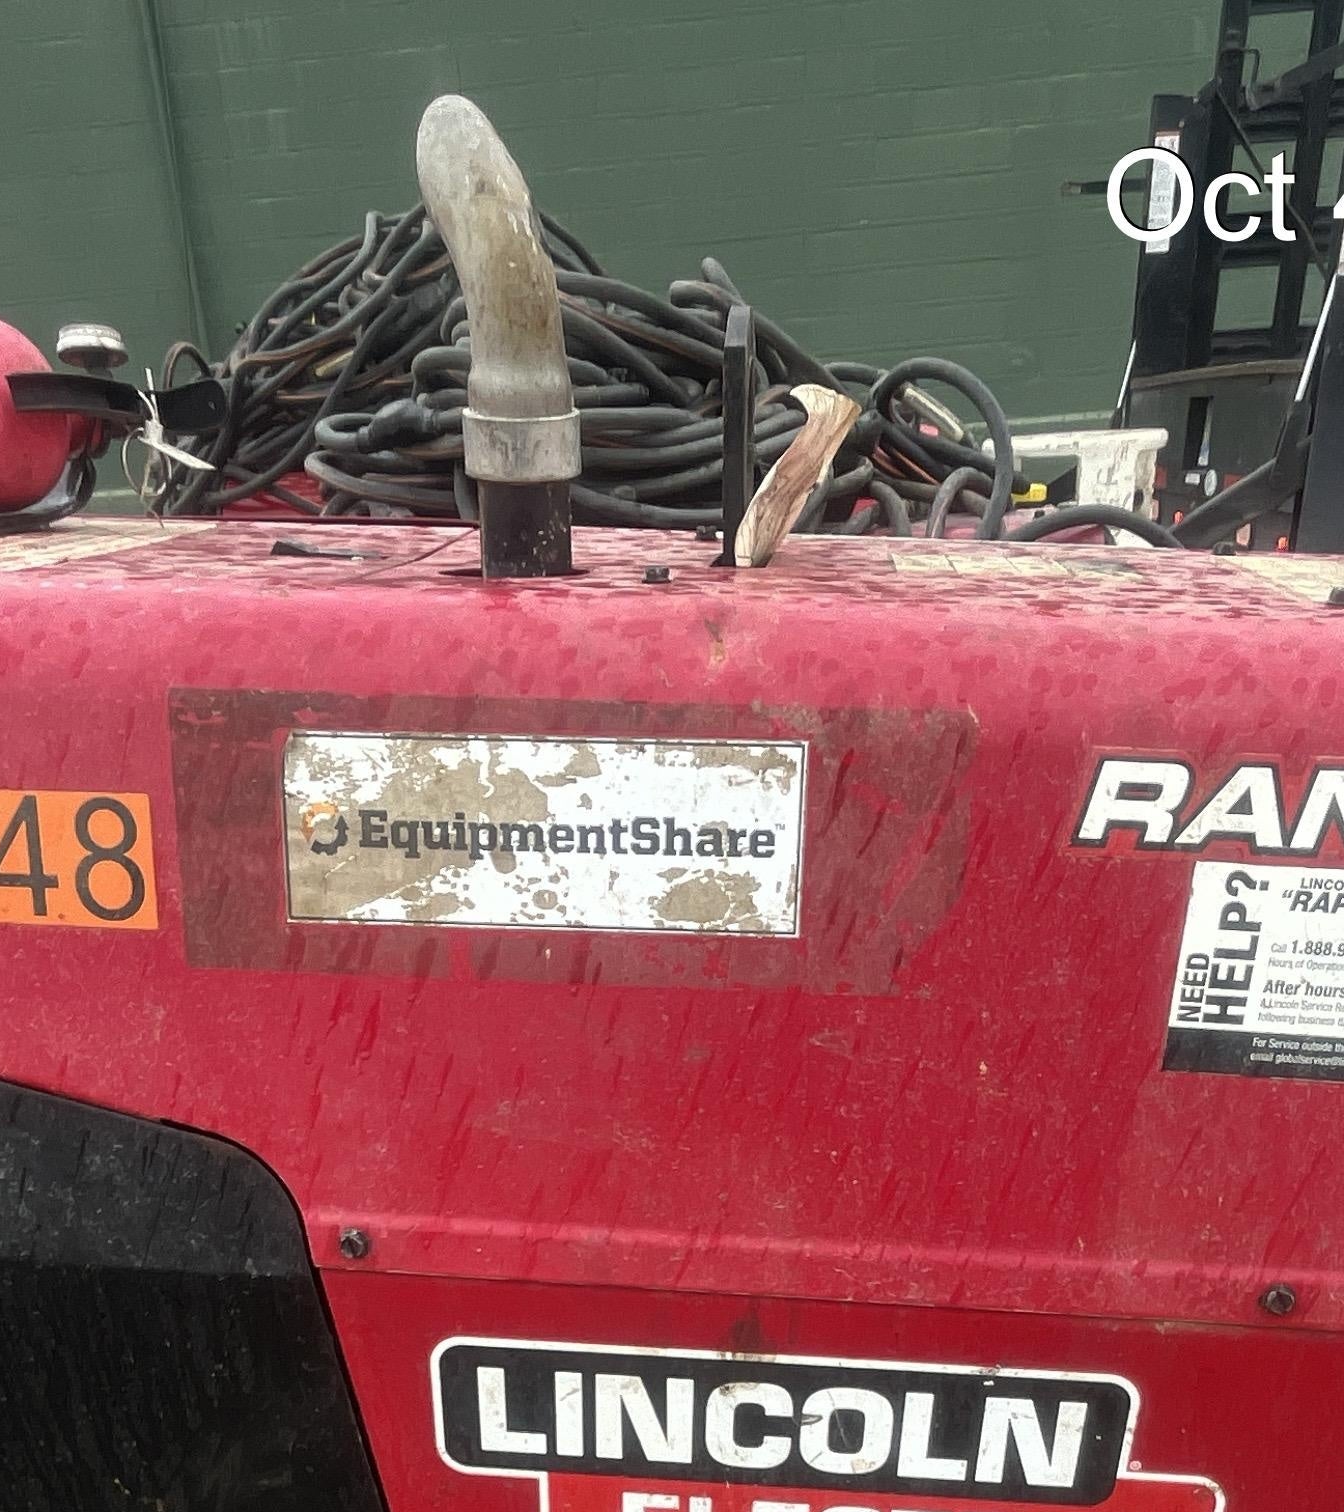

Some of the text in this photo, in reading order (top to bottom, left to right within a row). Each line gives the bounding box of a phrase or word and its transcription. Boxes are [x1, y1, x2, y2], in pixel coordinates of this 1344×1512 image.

[358, 809, 776, 860] EquipmentShare
[1201, 869, 1270, 1025] HELP?
[1270, 943, 1288, 954] Call
[1267, 956, 1294, 969] Hours
[1294, 959, 1305, 968] of
[1176, 952, 1210, 1022] NEED
[1262, 979, 1302, 996] After
[1300, 1000, 1334, 1012] Service
[1257, 1012, 1297, 1025] following
[1252, 1036, 1268, 1048] For
[1268, 1038, 1301, 1050] Service
[1301, 1041, 1334, 1052] outside
[476, 1365, 1090, 1489] LINCOLN
